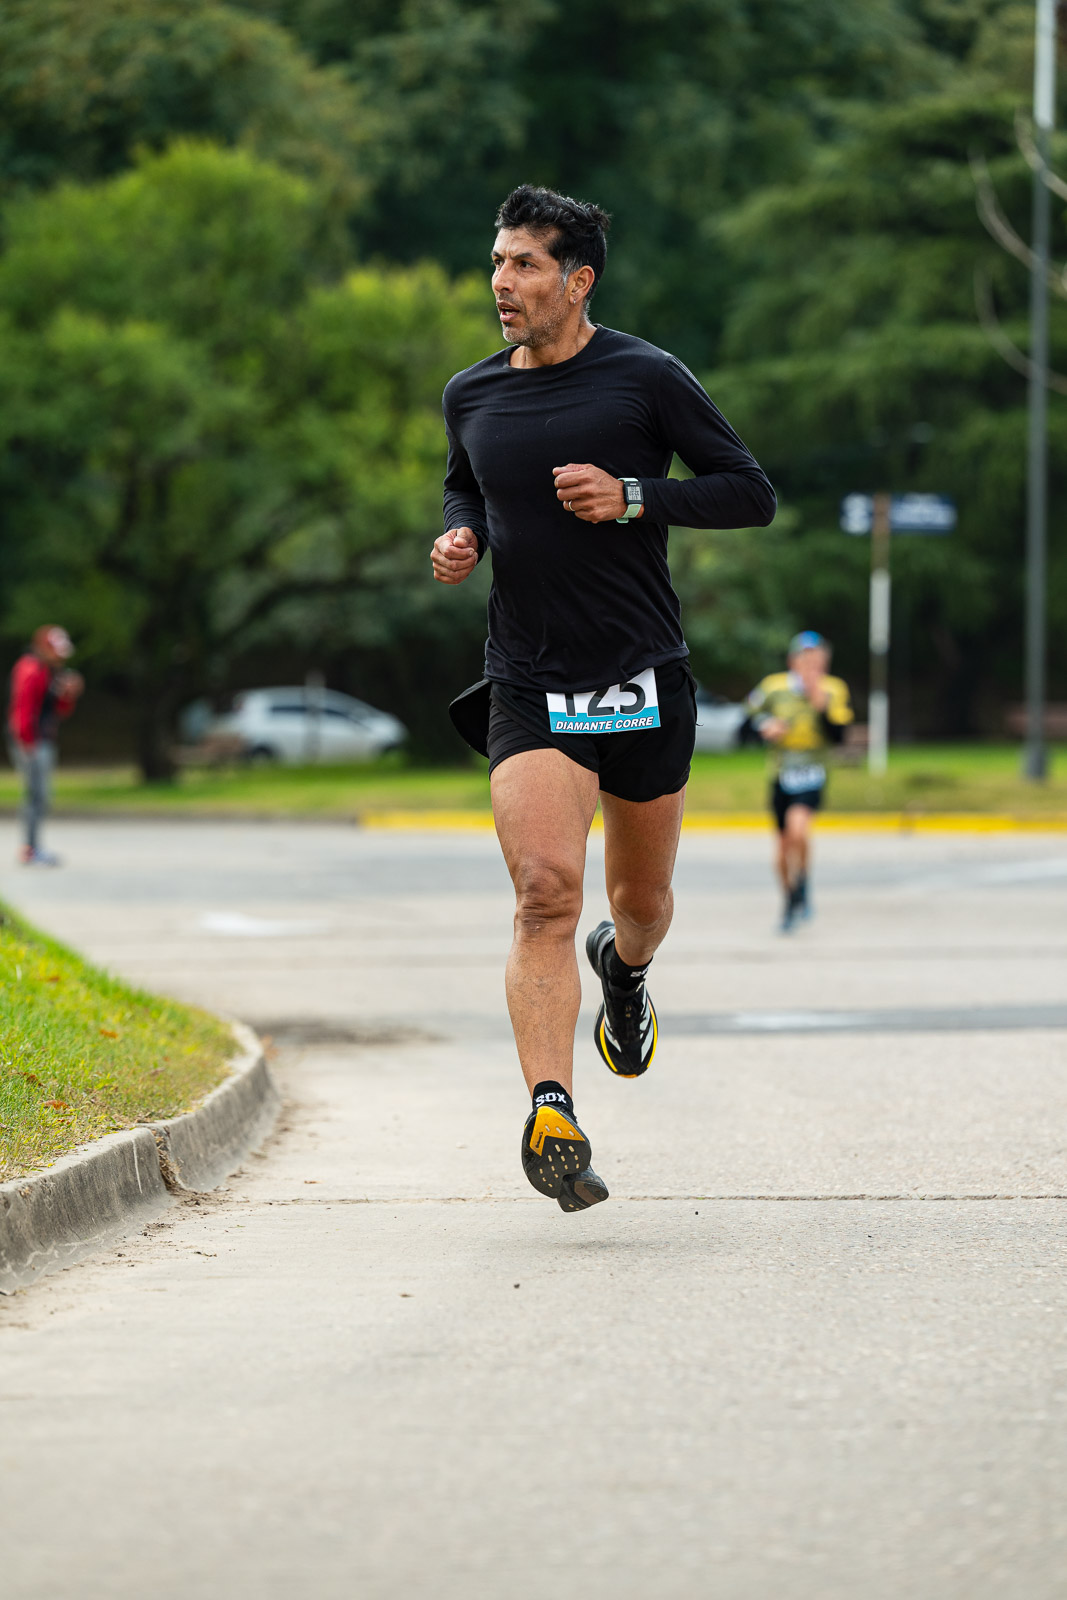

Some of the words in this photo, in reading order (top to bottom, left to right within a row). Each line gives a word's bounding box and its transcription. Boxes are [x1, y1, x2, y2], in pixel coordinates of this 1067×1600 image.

[555, 720, 613, 731] DIAMANTE
[615, 716, 654, 729] CORRE
[535, 1092, 567, 1108] SOX
